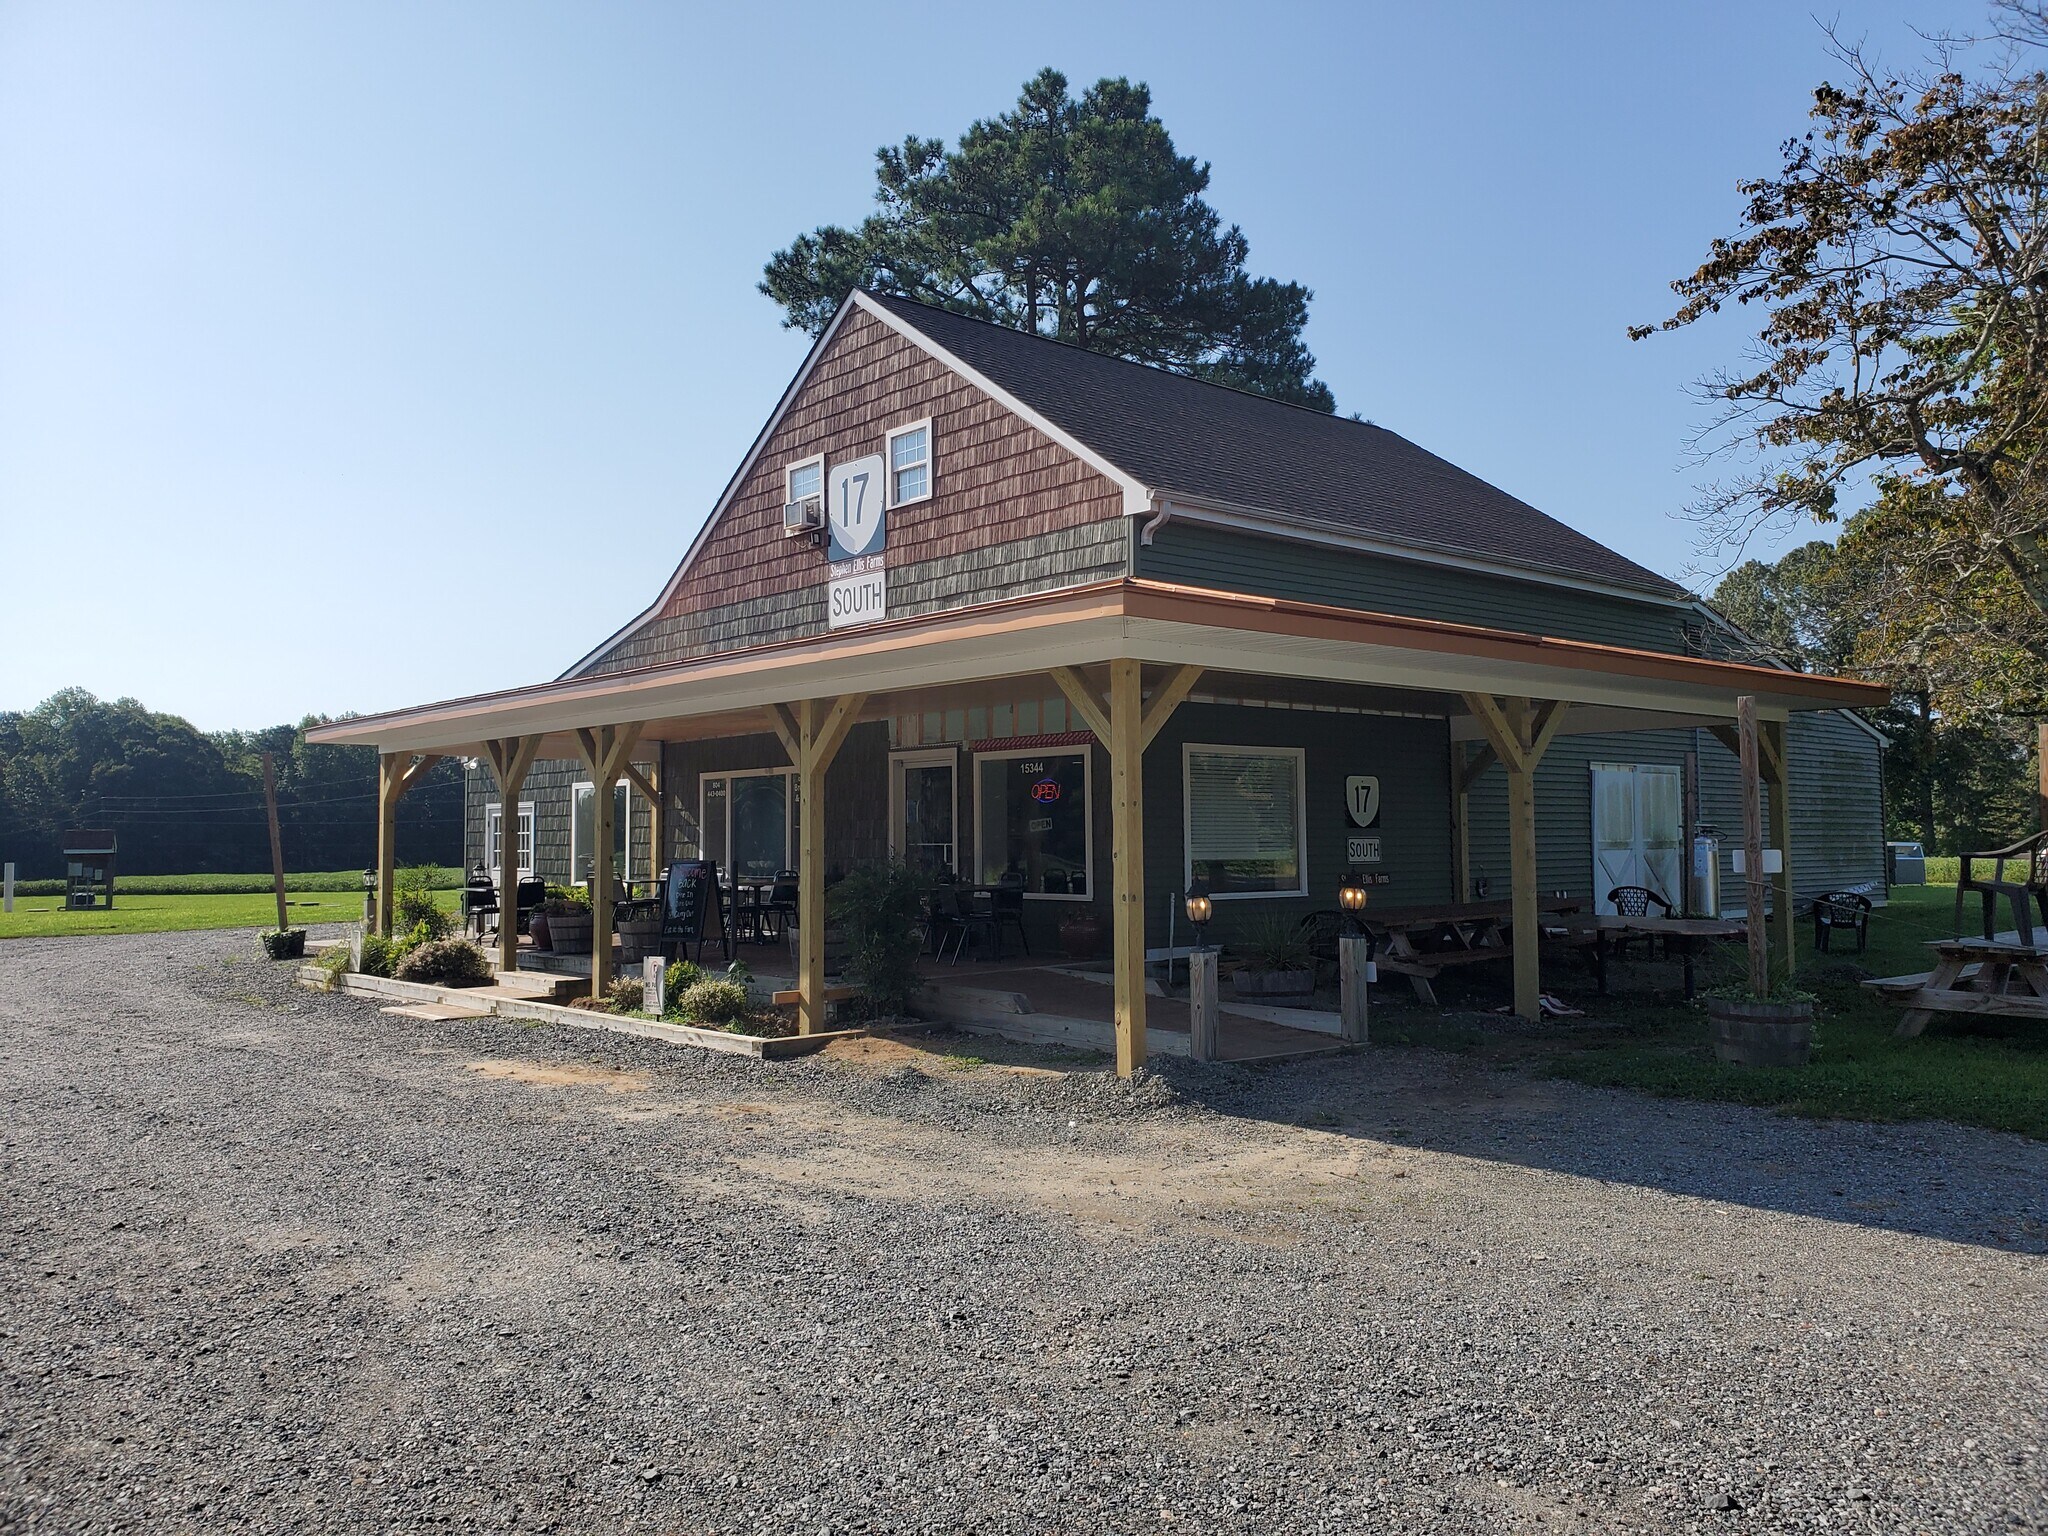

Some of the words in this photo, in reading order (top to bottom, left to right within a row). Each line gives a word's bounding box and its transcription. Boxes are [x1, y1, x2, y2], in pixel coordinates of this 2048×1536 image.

[842, 472, 869, 527] 17
[830, 562, 851, 578] Stephen
[853, 558, 865, 571] Ellis
[867, 556, 884, 570] Farms
[833, 581, 882, 617] SOUTH
[1020, 762, 1044, 774] 15344
[1031, 784, 1060, 799] OPEN
[1355, 785, 1371, 813] 17
[1031, 819, 1051, 830] OPEN
[1349, 842, 1379, 857] SOUTH
[1362, 873, 1373, 884] Ellis
[1375, 873, 1389, 883] Farms
